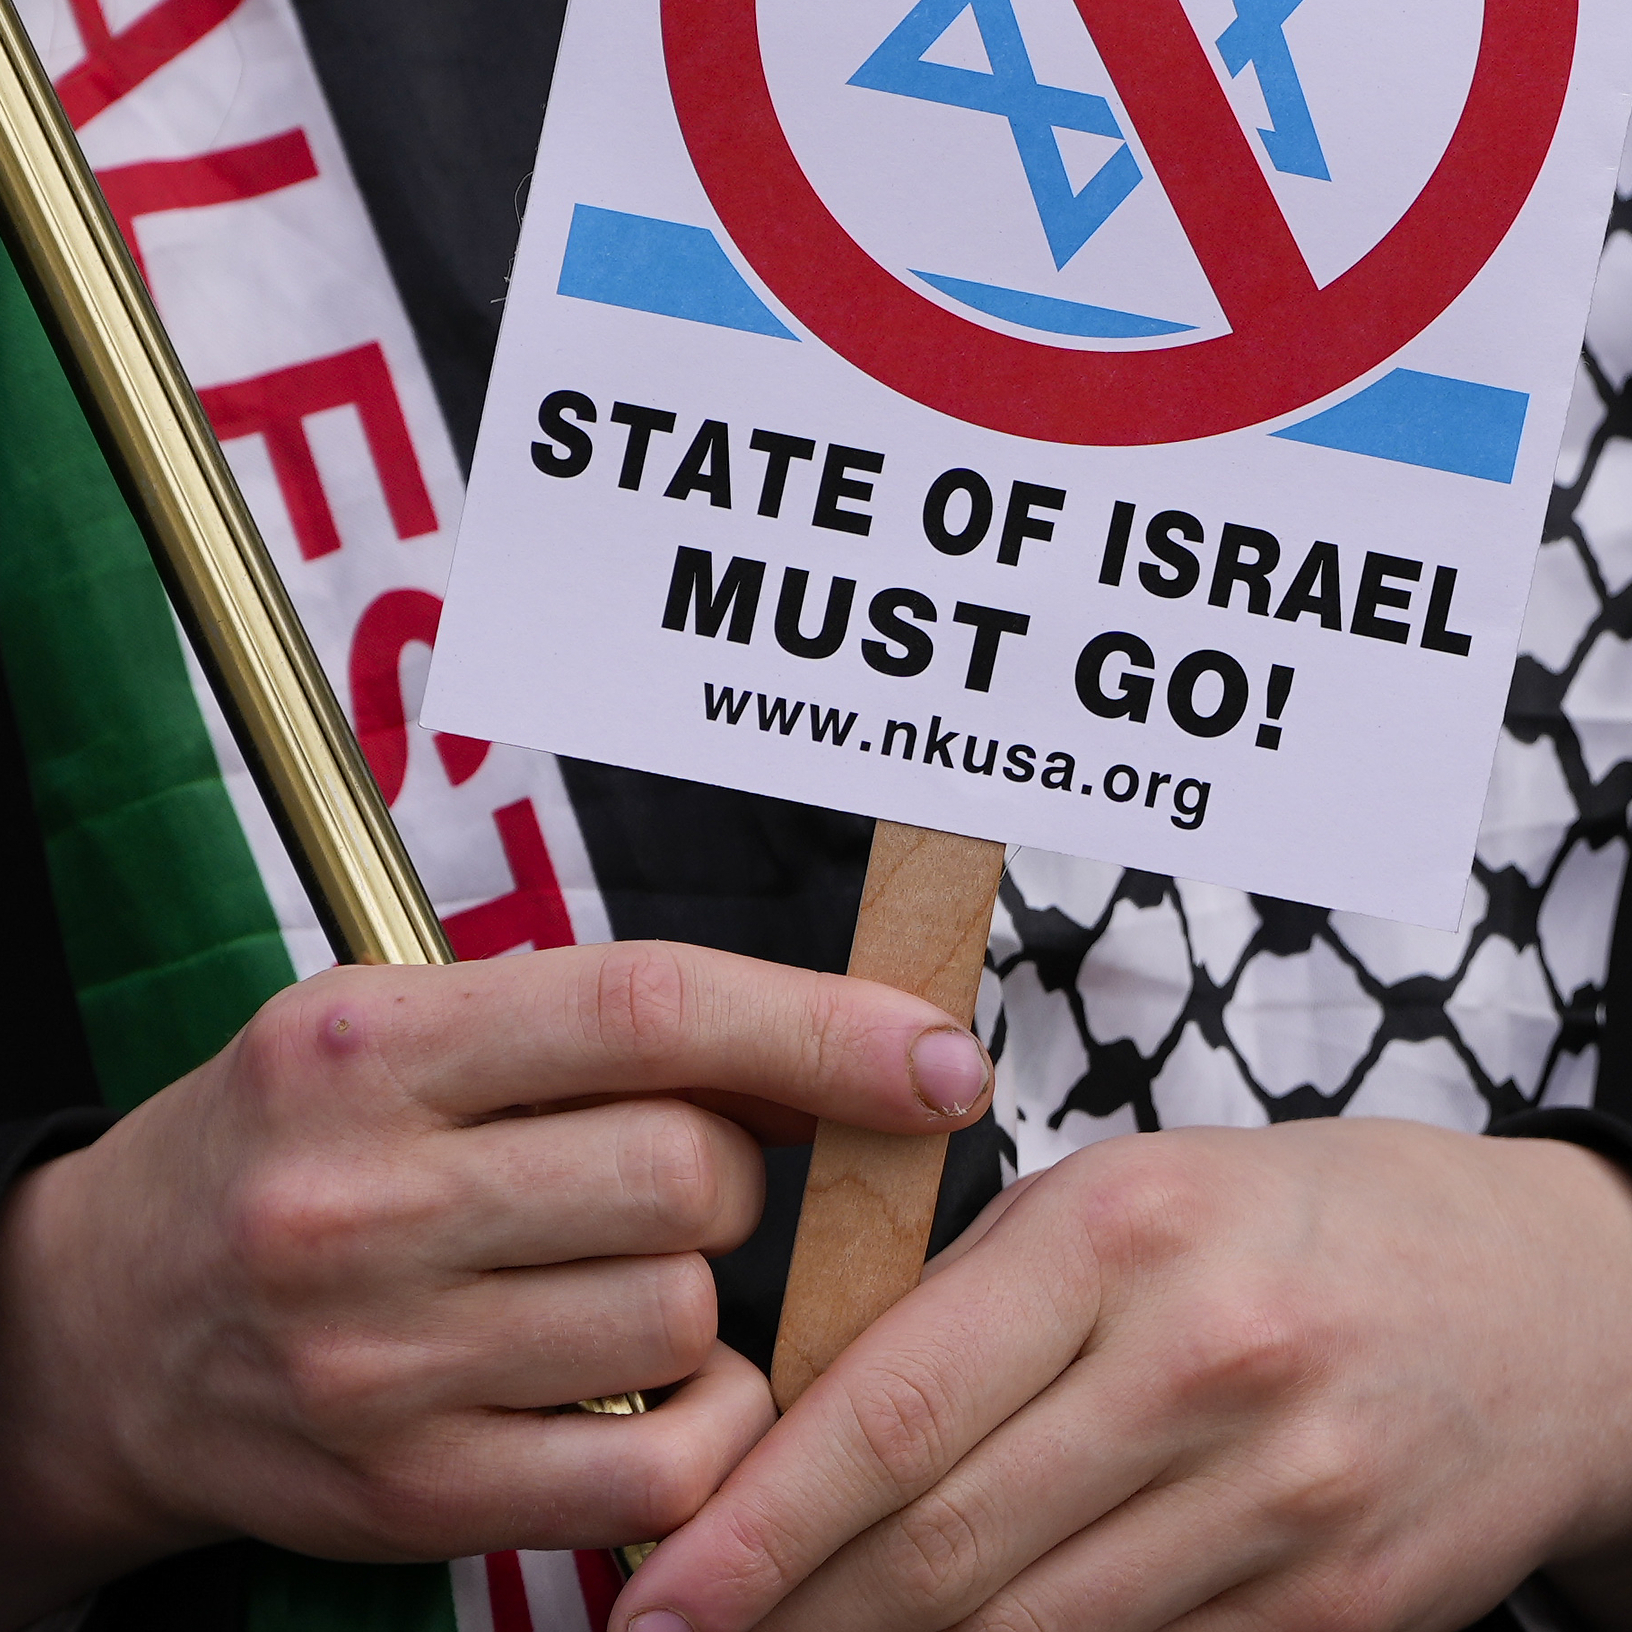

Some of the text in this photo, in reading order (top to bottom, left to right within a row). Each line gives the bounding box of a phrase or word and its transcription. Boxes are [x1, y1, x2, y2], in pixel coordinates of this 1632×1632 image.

[529, 388, 1474, 658] STATE OF ISRAEL
[660, 544, 1296, 752] MUST GO!
[703, 681, 1213, 832] www.nkusa.org
